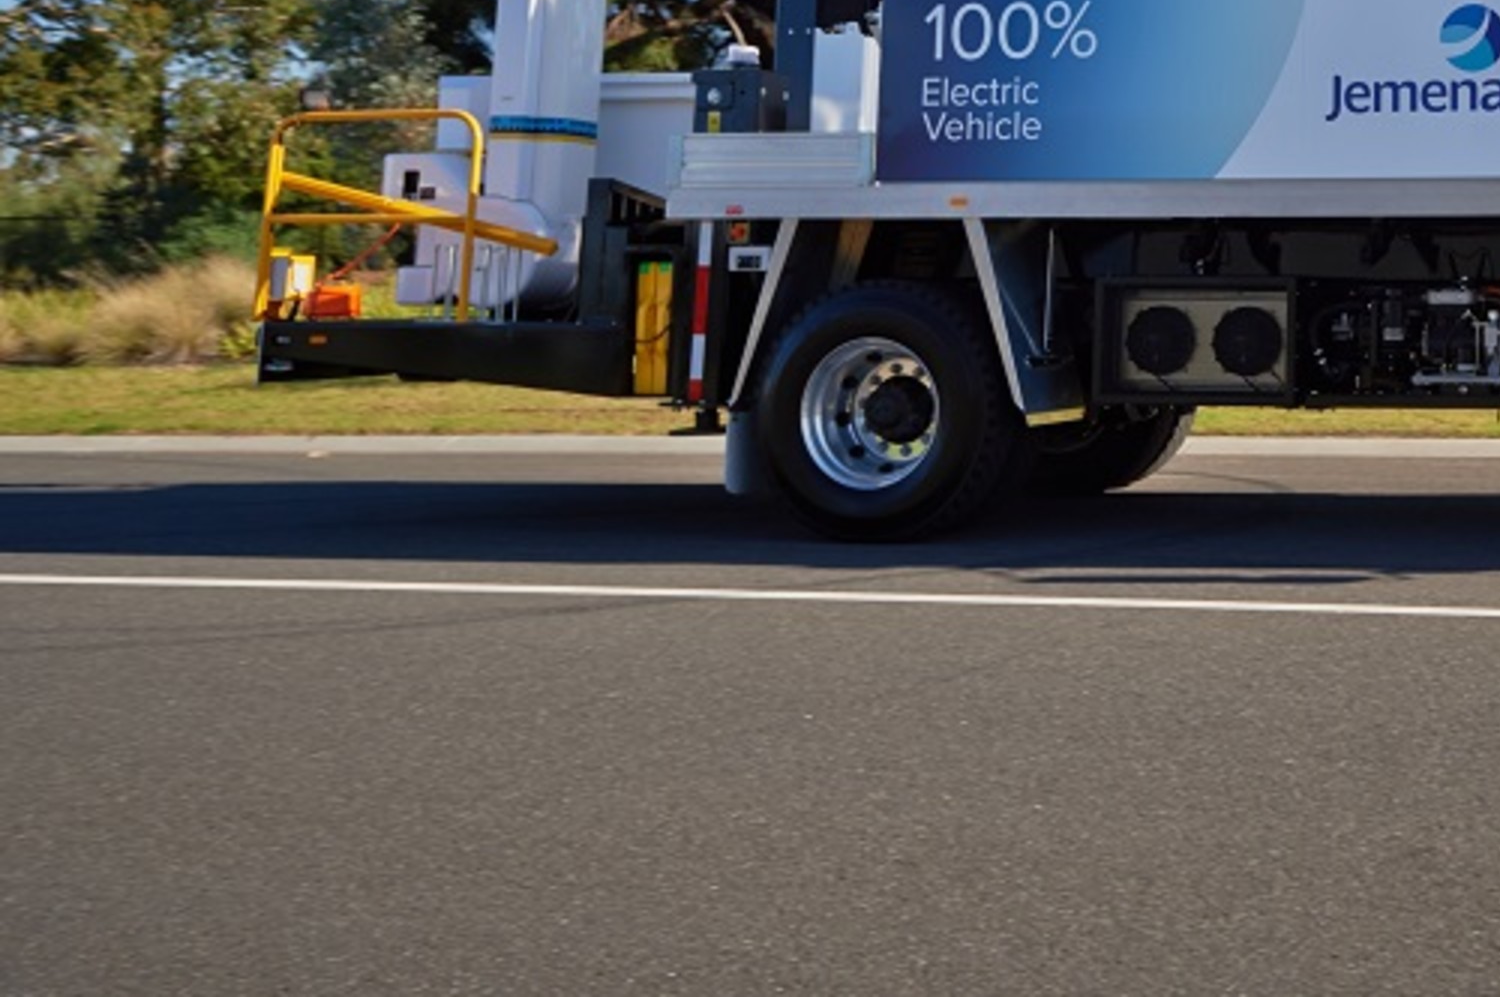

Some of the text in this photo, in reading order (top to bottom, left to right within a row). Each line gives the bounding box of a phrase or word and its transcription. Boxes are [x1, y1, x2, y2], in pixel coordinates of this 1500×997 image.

[922, 0, 1098, 62] 100%
[921, 75, 1040, 107] Electric
[921, 111, 1042, 142] Vehicle
